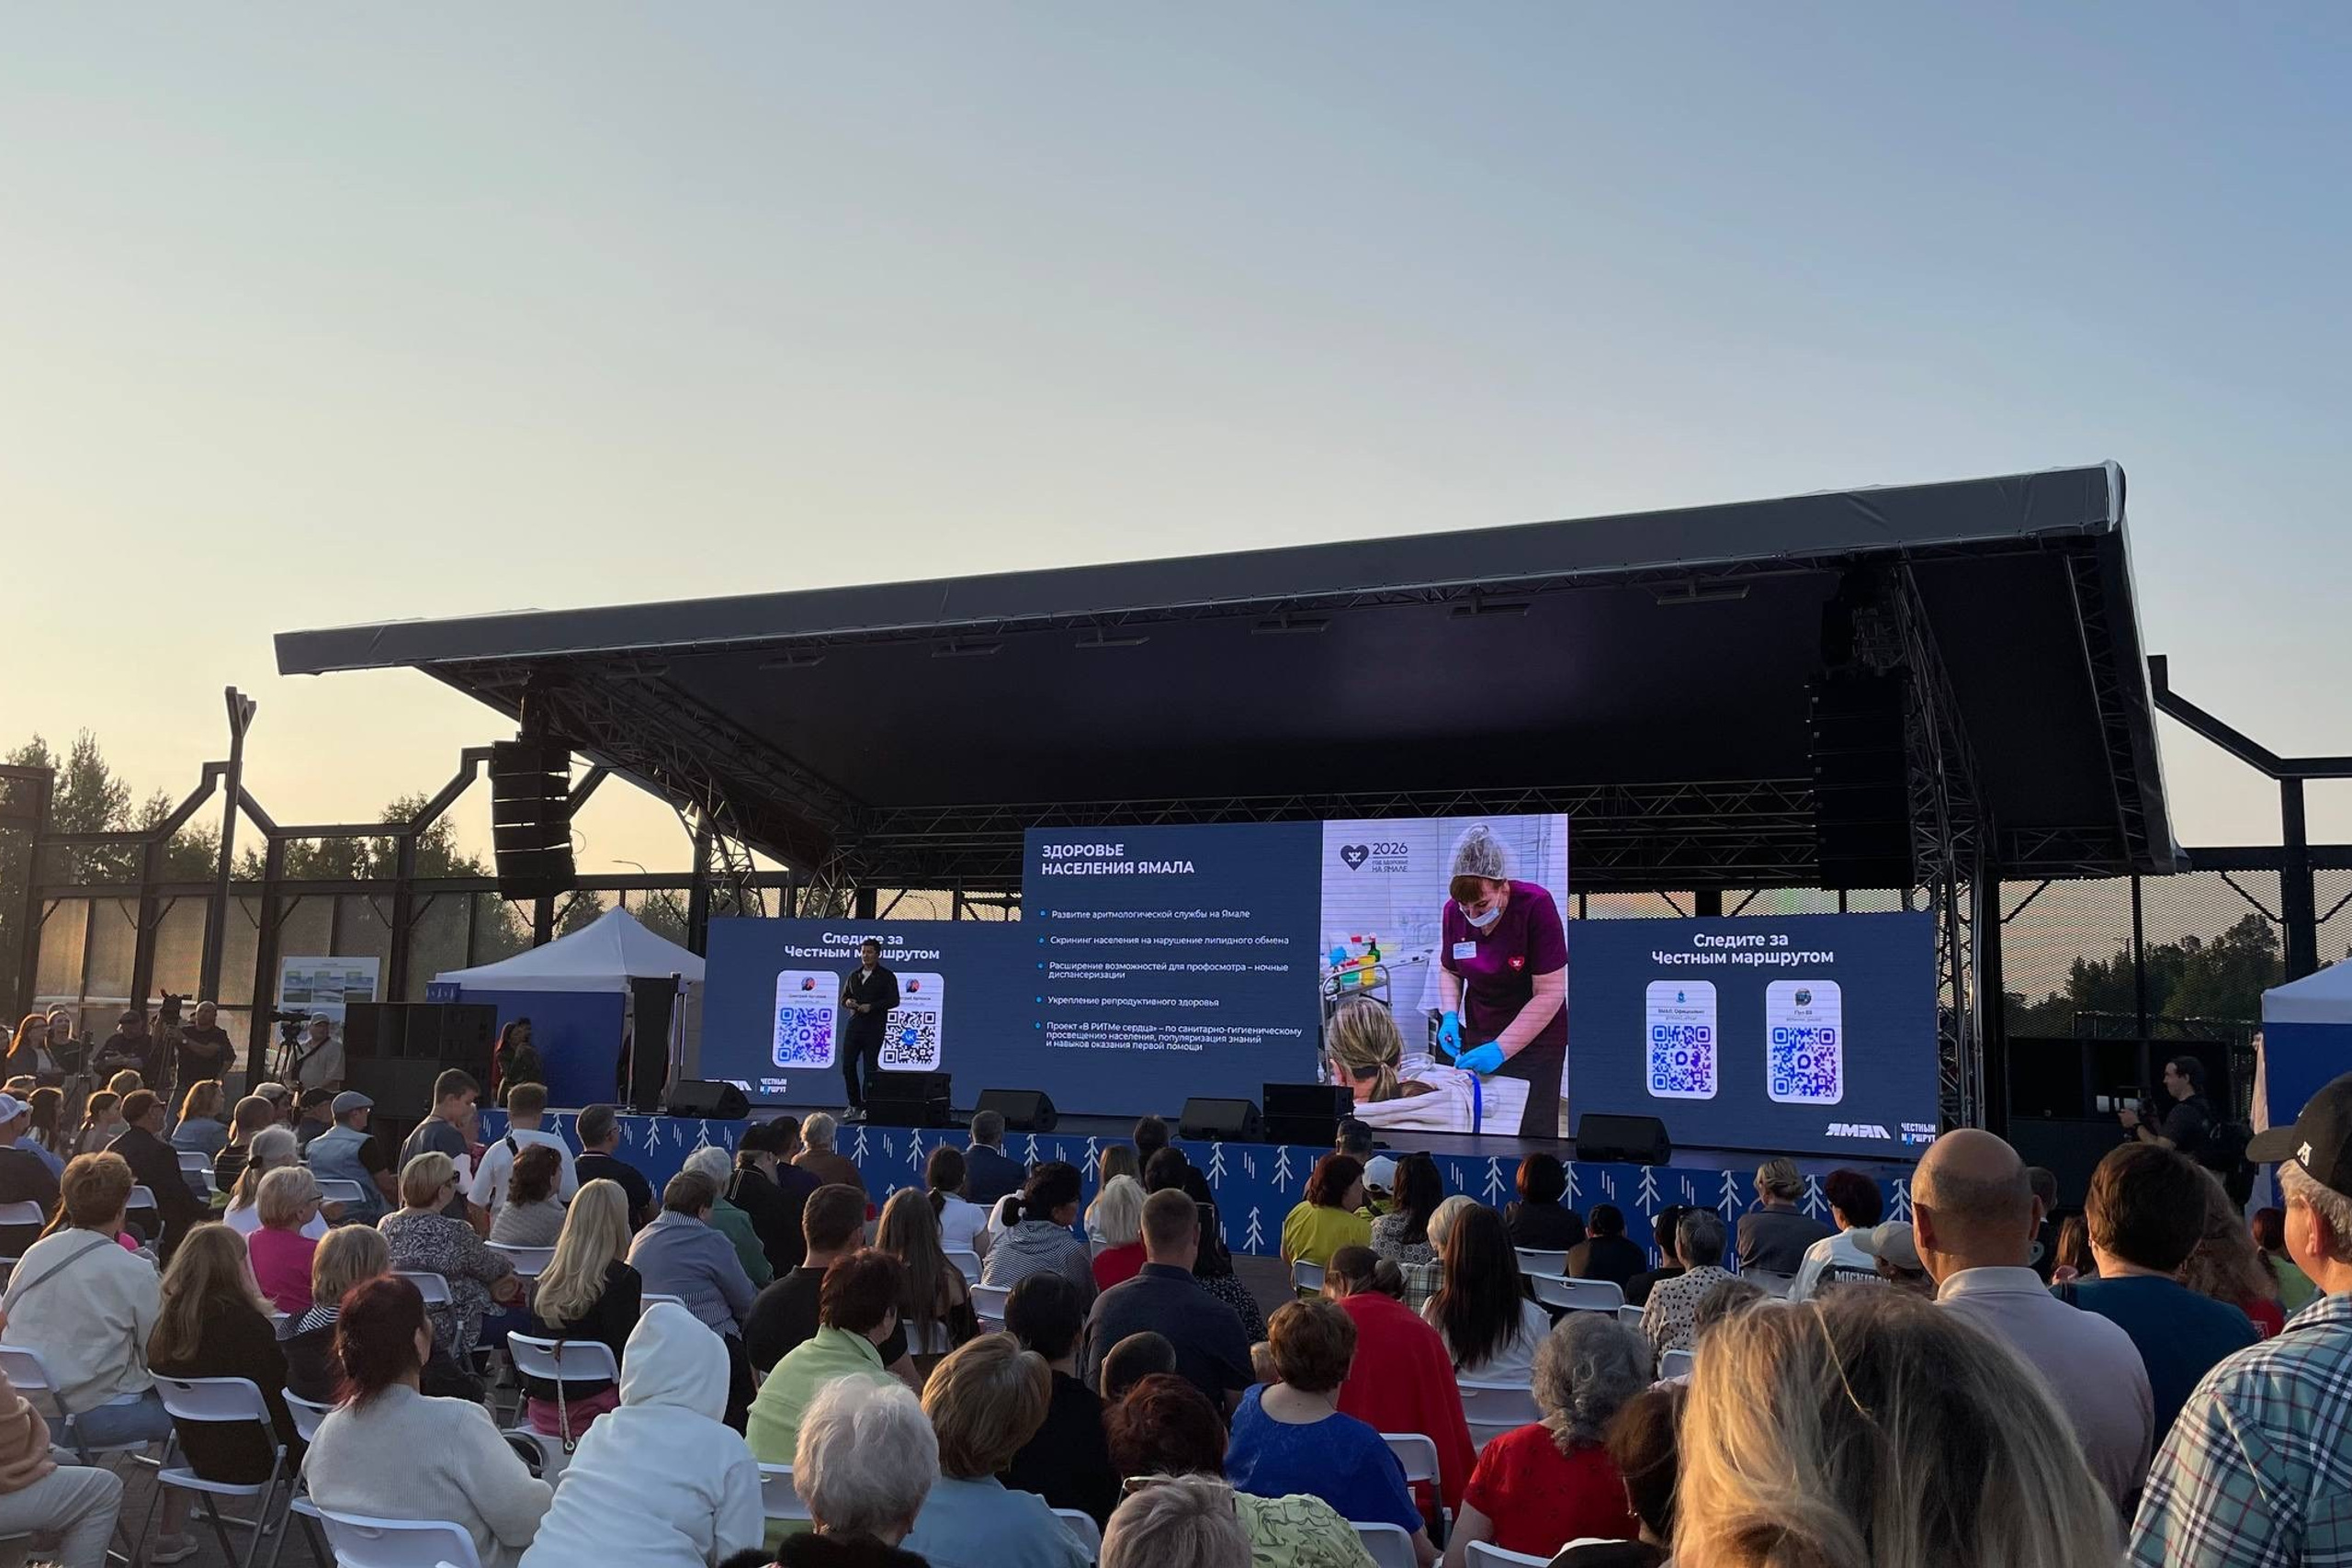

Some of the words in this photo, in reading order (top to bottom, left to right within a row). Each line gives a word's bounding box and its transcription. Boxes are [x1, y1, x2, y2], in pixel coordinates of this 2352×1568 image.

[1042, 843, 1125, 859] ЗДОРОВЬЕ
[1373, 842, 1408, 854] 2026
[1042, 862, 1134, 874] НАСЕЛЕНИЯ
[1138, 861, 1194, 874] ЯМАЛА
[1052, 910, 1091, 919] Развитие
[1092, 910, 1172, 919] аритмологической
[1174, 909, 1207, 919] службы
[1221, 909, 1250, 919] Ямале
[888, 935, 903, 944] за
[1050, 936, 1092, 945] Скрининг
[1153, 937, 1203, 946] нарушение
[1204, 937, 1253, 945] липидного
[1255, 935, 1289, 945] обмена
[1693, 933, 1766, 948] Следите
[1770, 934, 1789, 946] за
[785, 945, 851, 958] Честным
[854, 948, 940, 962] мшрутом
[1652, 951, 1726, 964] Честным
[1731, 951, 1834, 966] маршрутом
[1049, 961, 1103, 971] Расширение
[1105, 963, 1167, 971] возможностей
[1186, 963, 1246, 973] профосмотра
[1048, 972, 1125, 980] диспансеризации
[1047, 996, 1100, 1006] Укрепление
[1102, 998, 1176, 1007] репродуктивного
[1178, 999, 1219, 1008] здоровья
[1046, 1021, 1078, 1031] Проект
[1091, 1022, 1121, 1031] РИТМе
[1178, 1026, 1303, 1037] санитарно-гигиеническому
[1046, 1032, 1107, 1040] просвещению
[1159, 1034, 1227, 1043] популяризация
[1228, 1035, 1262, 1043] знаний
[1132, 1042, 1164, 1050] первой
[1166, 1043, 1203, 1051] помощи
